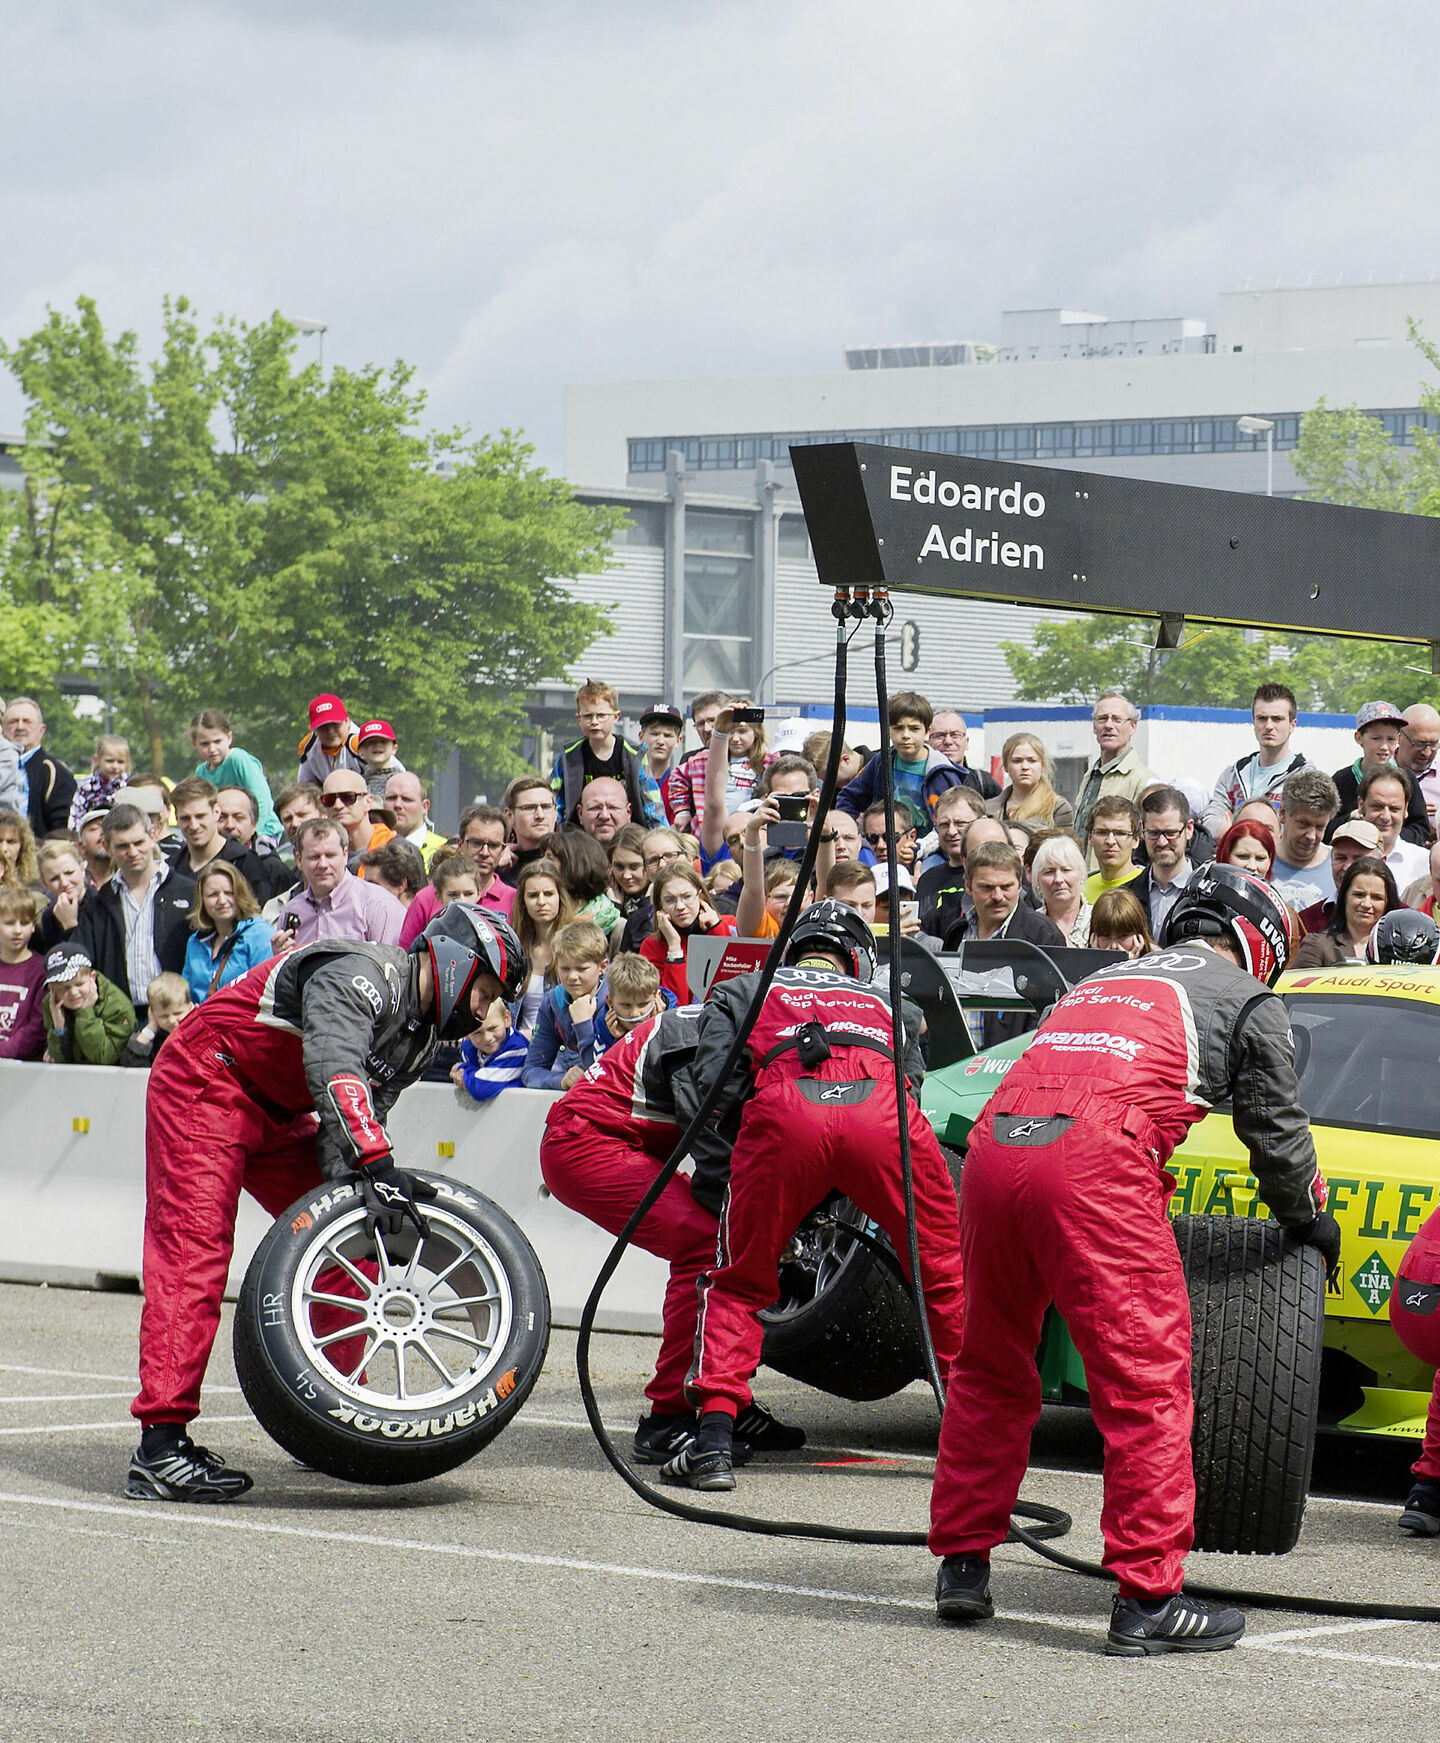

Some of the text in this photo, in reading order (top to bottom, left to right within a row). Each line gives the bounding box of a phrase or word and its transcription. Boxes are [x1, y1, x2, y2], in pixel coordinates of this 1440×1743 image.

[890, 465, 1046, 518] Edoardo
[919, 524, 1044, 570] Adrien
[1260, 917, 1286, 969] uvex
[1066, 986, 1104, 999] Audi
[1320, 976, 1437, 994] Audi Sport
[1060, 994, 1153, 1011] Top Service
[360, 1116, 377, 1143] Sport
[1359, 1273, 1391, 1290] INA
[262, 1293, 286, 1326] HR
